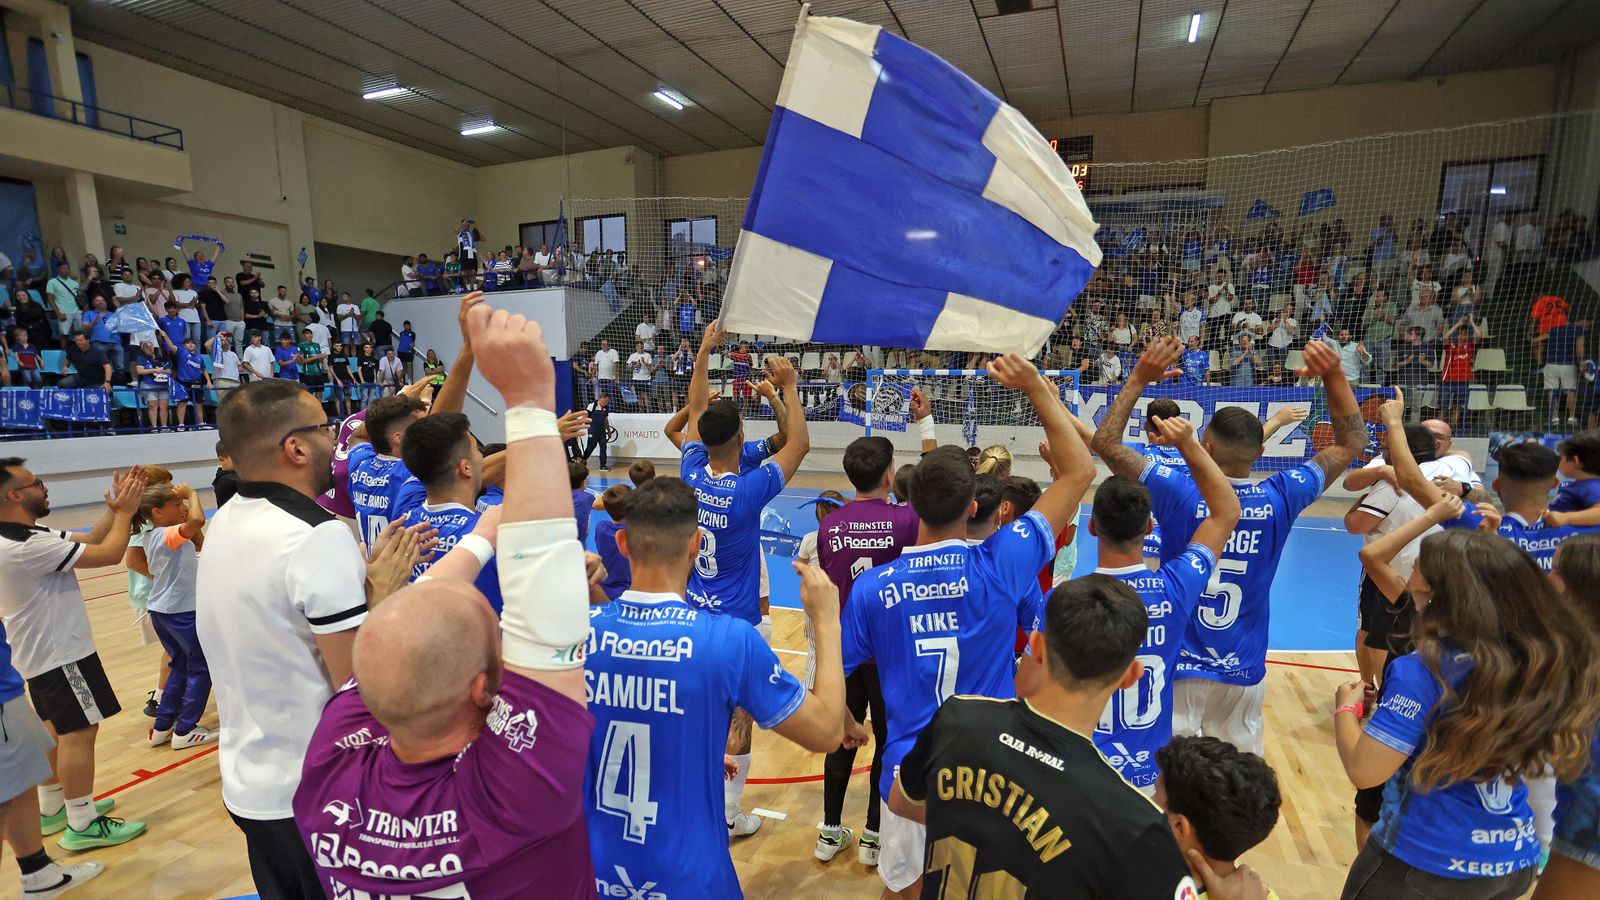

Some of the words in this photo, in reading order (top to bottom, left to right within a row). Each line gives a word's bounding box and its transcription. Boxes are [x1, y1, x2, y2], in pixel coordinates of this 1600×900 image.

[623, 430, 660, 439] NIMAUTO
[849, 521, 893, 531] TRANSTER
[1197, 558, 1248, 630] 5
[621, 603, 697, 621] TRANSTER
[909, 612, 959, 634] KIKE
[915, 636, 960, 707] 7
[583, 669, 684, 715] SAMUEL
[1389, 703, 1417, 720] SALUX
[596, 720, 658, 845] 4
[937, 766, 1072, 863] CRISTIAN
